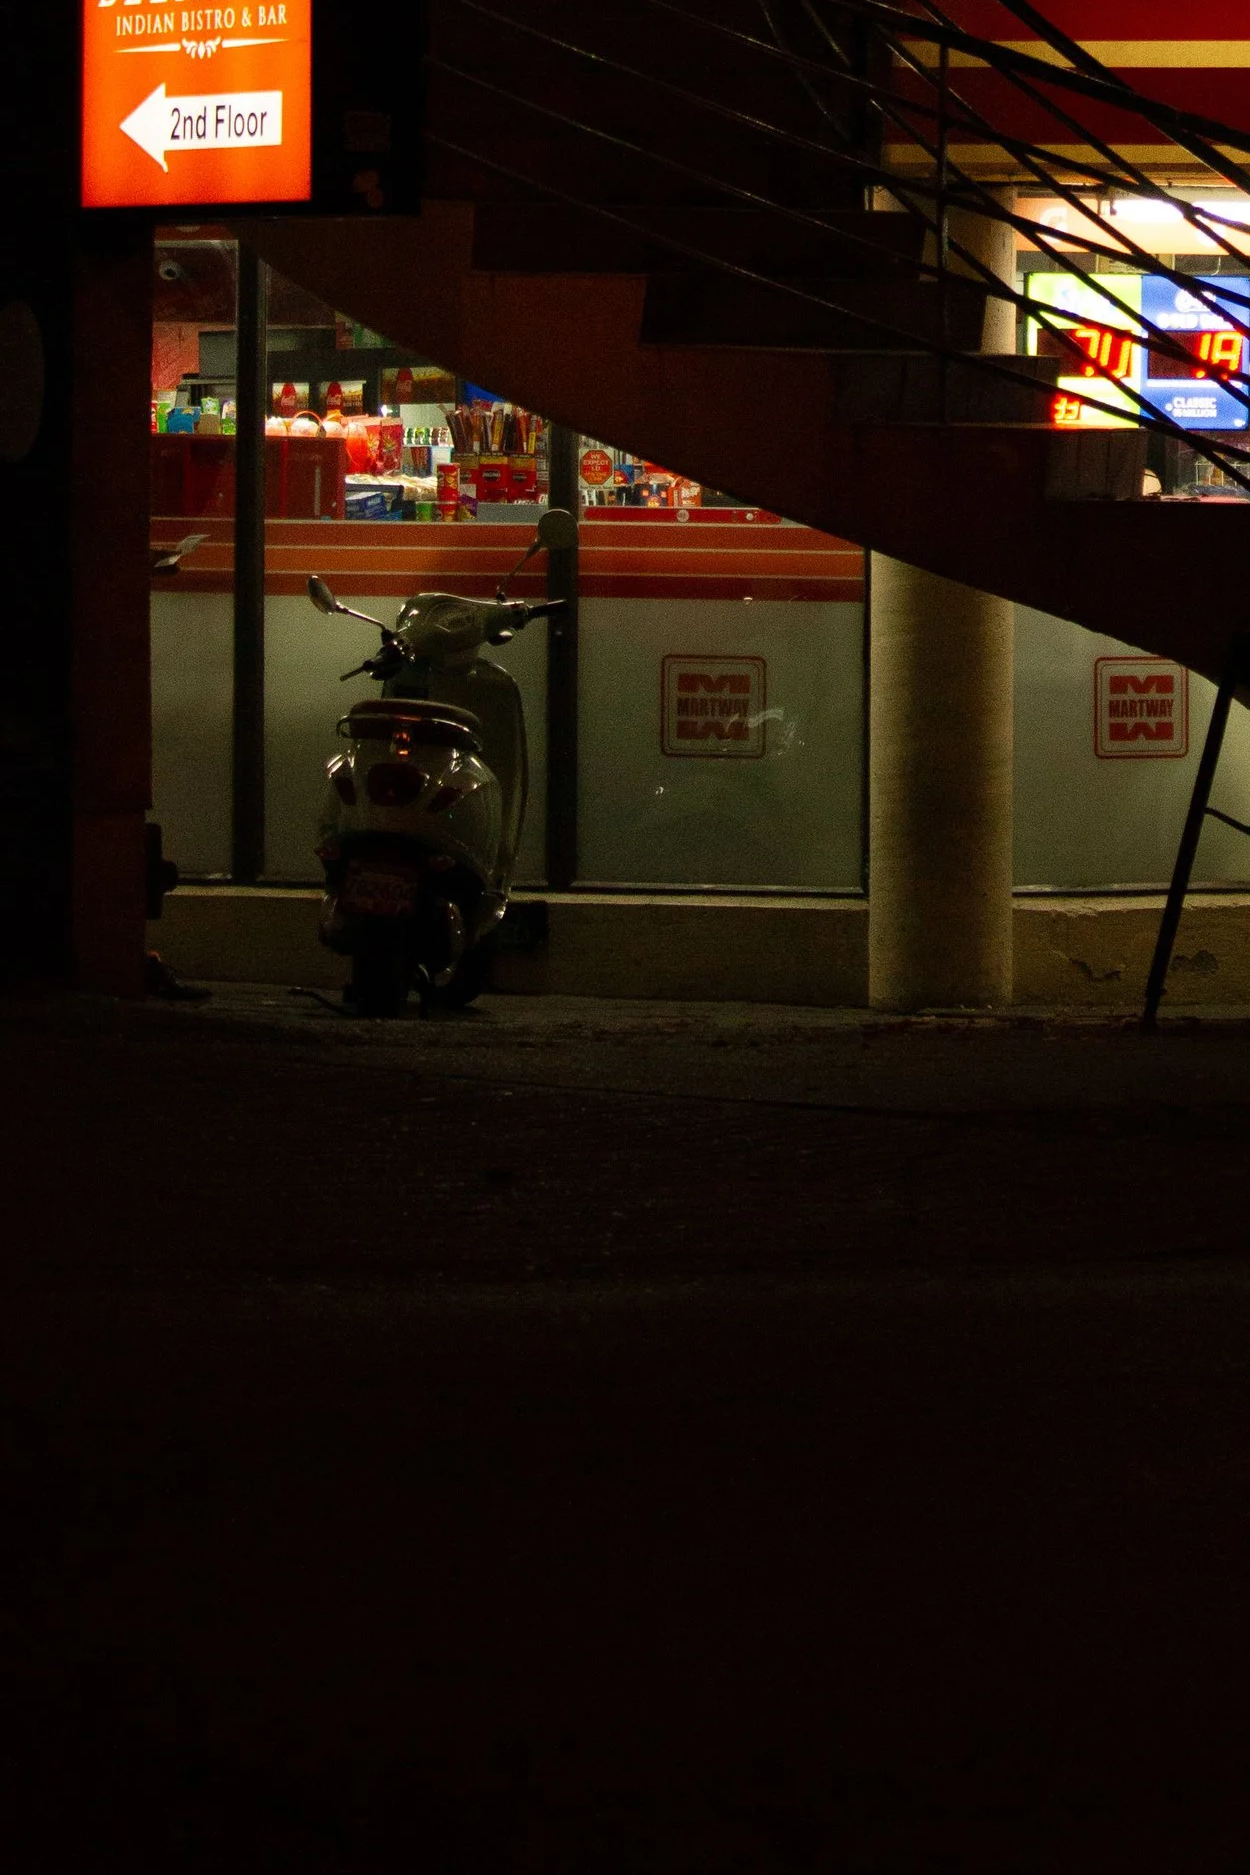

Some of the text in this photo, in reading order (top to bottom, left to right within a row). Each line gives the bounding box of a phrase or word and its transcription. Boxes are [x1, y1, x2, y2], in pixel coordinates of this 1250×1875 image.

[115, 4, 287, 37] INDIAN BISTRO & BAR
[170, 103, 268, 141] 2nd Floor
[676, 697, 750, 718] MARTWAY
[1108, 699, 1175, 718] MARTWAY
